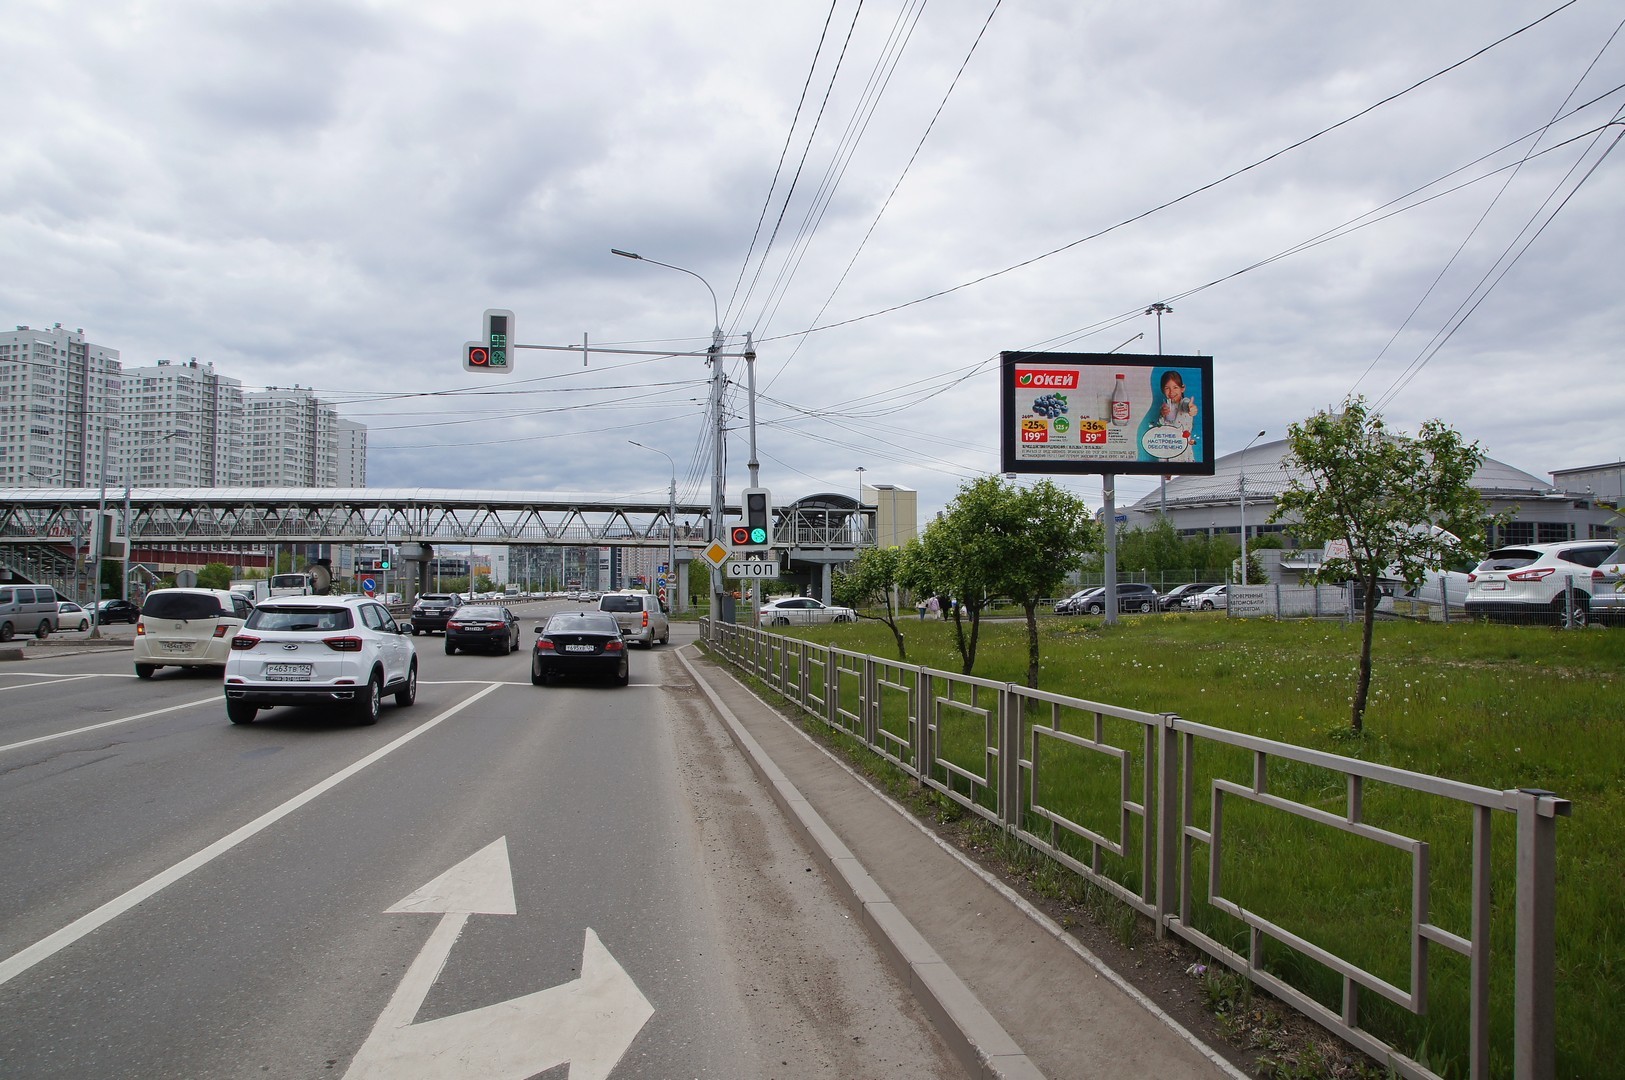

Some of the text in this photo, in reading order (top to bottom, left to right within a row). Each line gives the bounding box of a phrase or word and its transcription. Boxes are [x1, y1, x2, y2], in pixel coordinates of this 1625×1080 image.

[1024, 421, 1045, 429] -25%
[1083, 421, 1104, 430] -36%
[732, 564, 773, 576] СТОП
[269, 665, 297, 673] Р463ТВ
